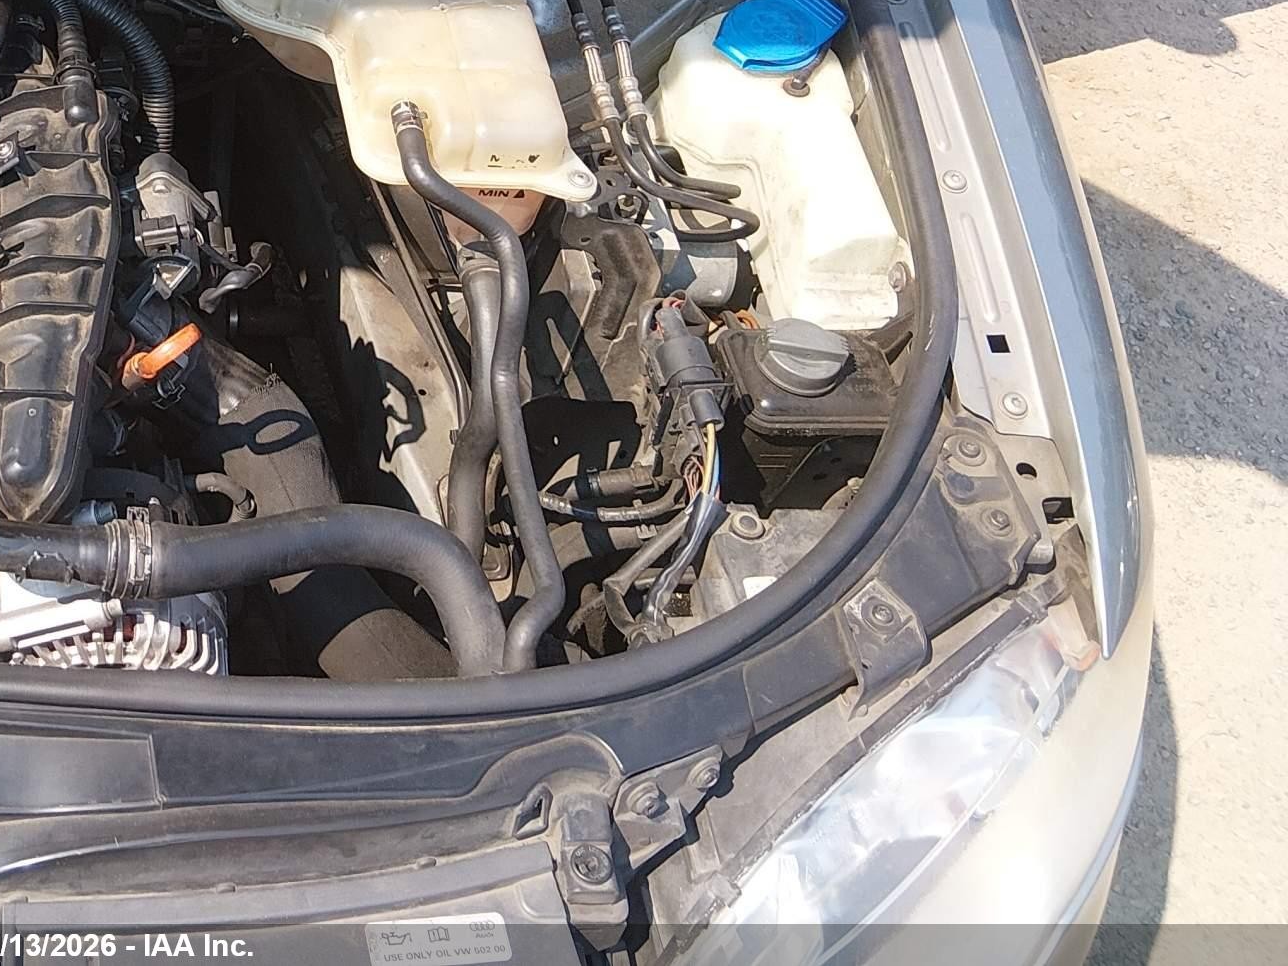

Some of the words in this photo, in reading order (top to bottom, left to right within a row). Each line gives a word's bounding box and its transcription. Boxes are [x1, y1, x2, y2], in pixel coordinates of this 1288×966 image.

[478, 189, 510, 198] MIN
[384, 953, 404, 962] USE
[406, 950, 433, 960] ONLY
[435, 949, 452, 957] OIL
[454, 946, 472, 956] VW
[473, 945, 492, 954] 502
[493, 944, 506, 952] 00
